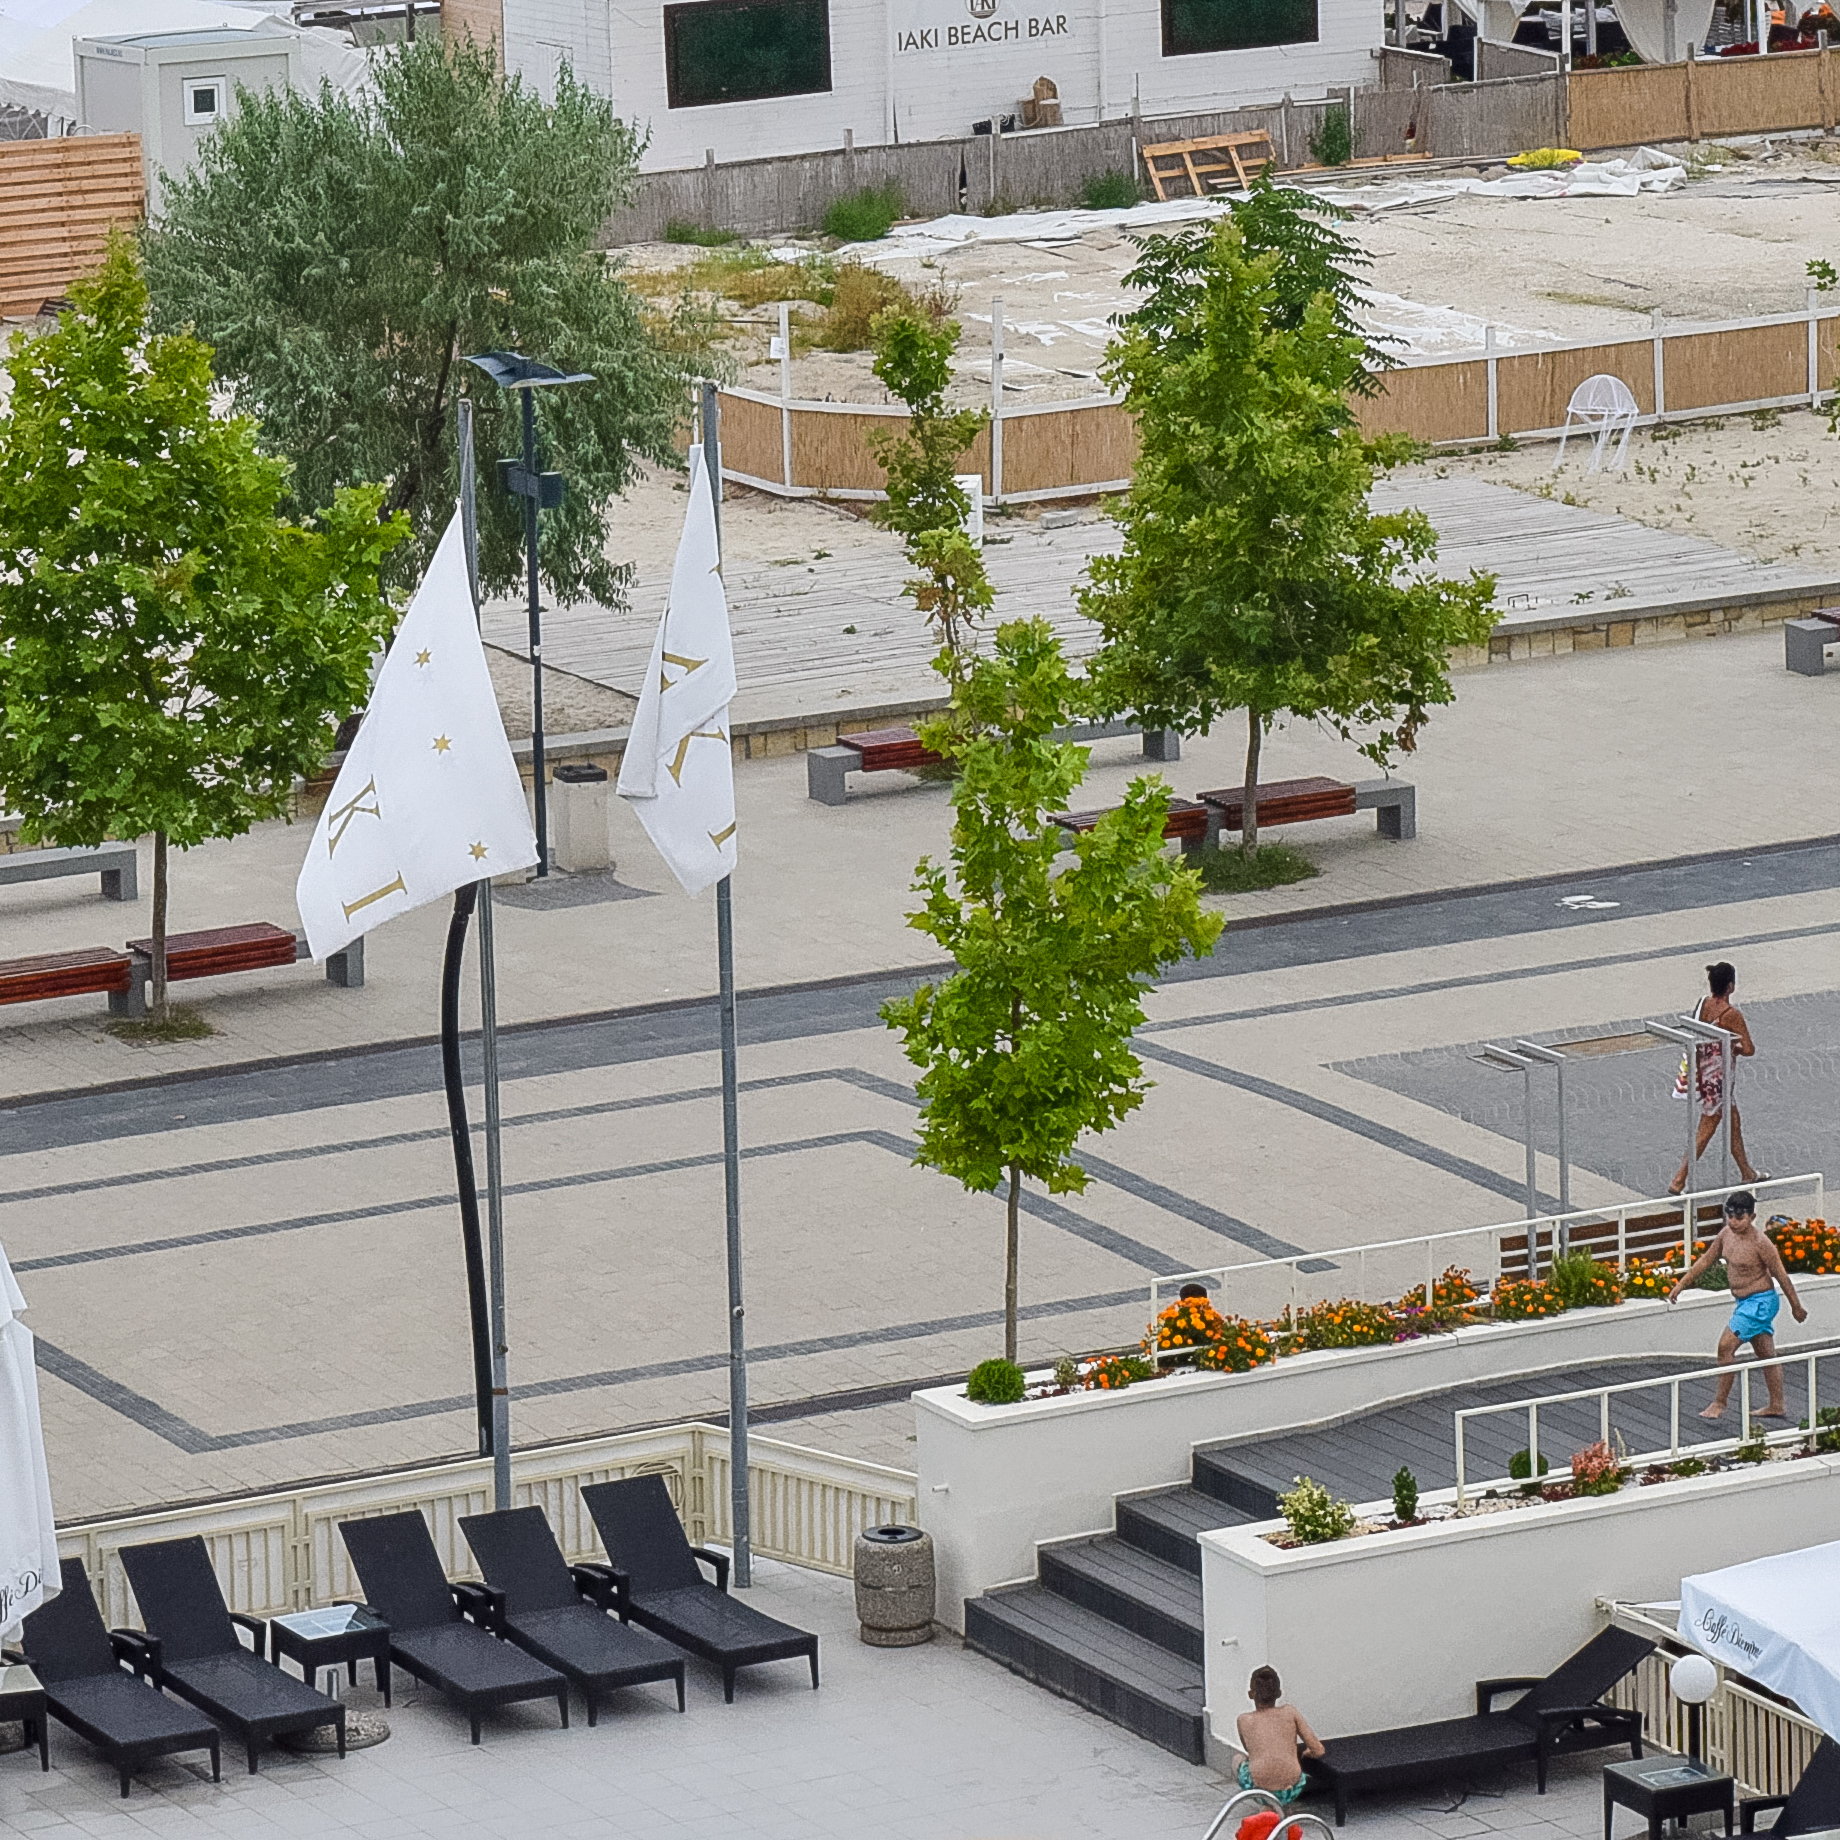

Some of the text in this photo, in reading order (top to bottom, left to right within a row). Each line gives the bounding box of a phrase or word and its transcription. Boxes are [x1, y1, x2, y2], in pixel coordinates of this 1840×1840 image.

[898, 15, 1068, 51] IAKI BEACH BAR
